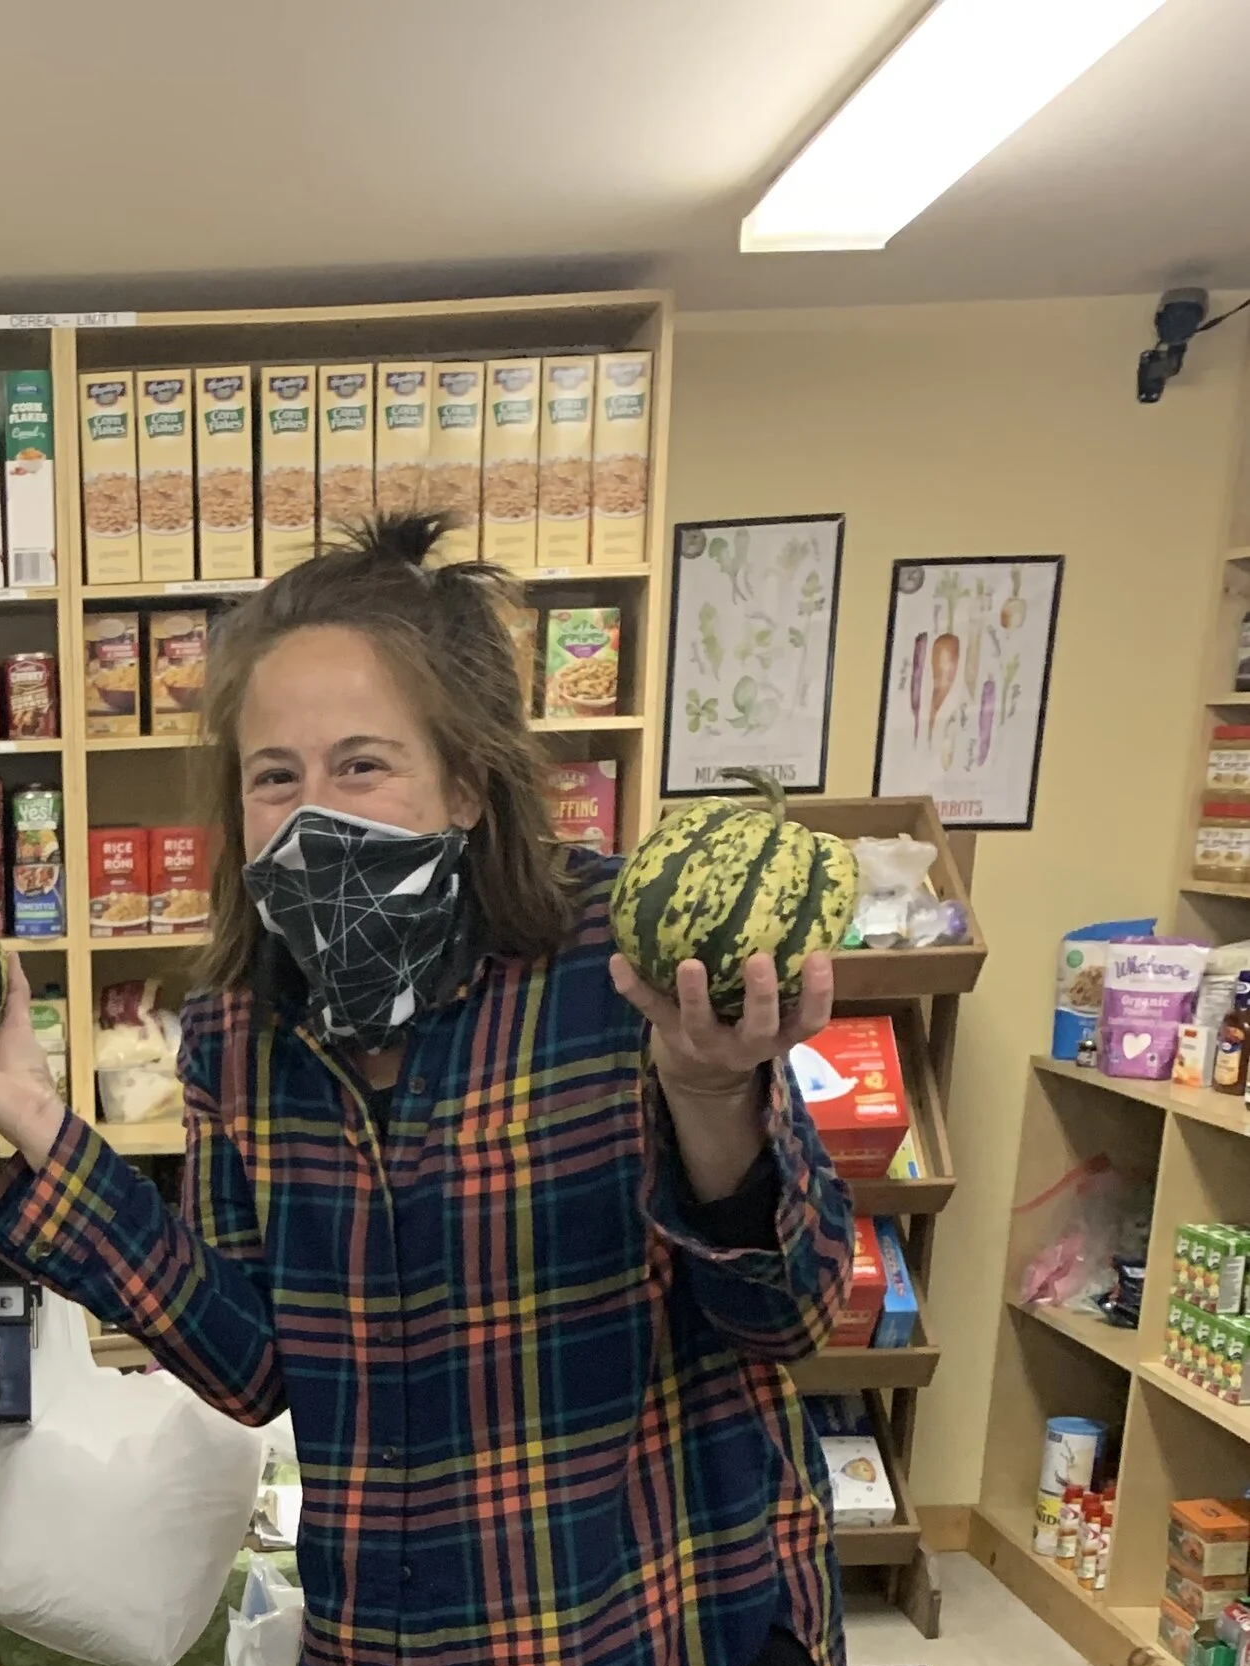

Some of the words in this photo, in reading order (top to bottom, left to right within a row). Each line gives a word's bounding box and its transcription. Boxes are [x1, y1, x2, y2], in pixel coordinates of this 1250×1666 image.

[9, 315, 59, 327] CEREAL
[77, 314, 108, 326] LIMIT
[12, 403, 43, 413] CORN
[333, 407, 360, 418] Corn
[391, 406, 418, 417] Corn
[443, 406, 471, 417] Corn
[10, 413, 48, 424] FLAKES
[94, 415, 121, 426] Corn
[151, 413, 179, 424] Corn
[210, 409, 238, 421] Corn
[275, 410, 302, 421] Corn
[19, 799, 54, 820] Yes!
[560, 797, 598, 818] FFING
[937, 800, 983, 818] RROTS
[103, 842, 134, 854] RICE
[164, 839, 194, 851] RICE
[104, 859, 134, 870] RONI
[164, 856, 195, 867] RONI
[1121, 995, 1170, 1009] Organic
